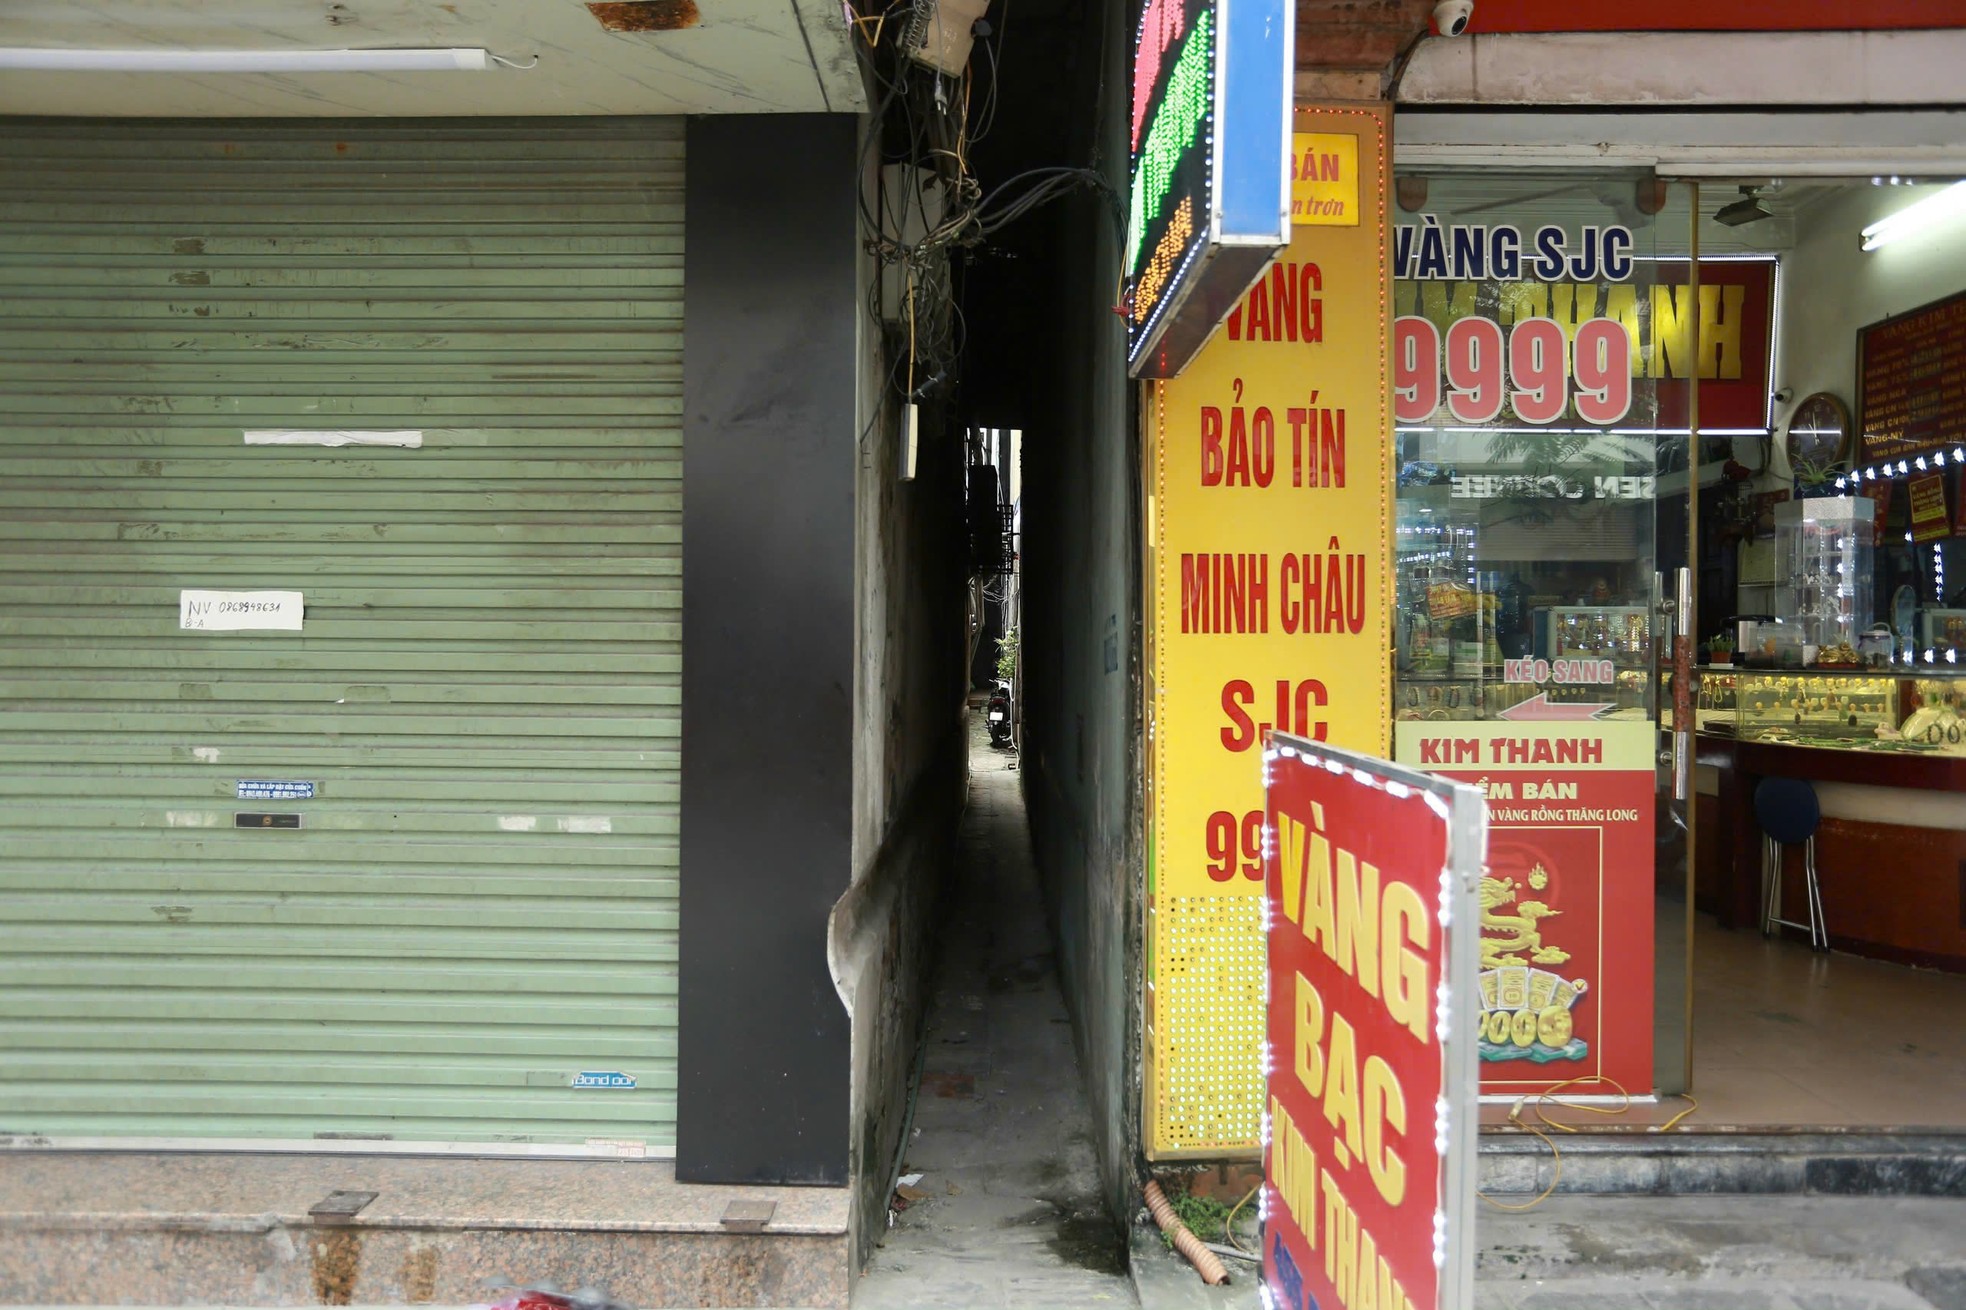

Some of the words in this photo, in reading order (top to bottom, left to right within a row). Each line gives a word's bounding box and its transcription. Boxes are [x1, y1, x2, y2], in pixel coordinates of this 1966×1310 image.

[1393, 213, 1522, 280] VÀNG
[1533, 224, 1634, 281] SJC
[1394, 315, 1631, 424] 9999
[1201, 378, 1275, 488] BẢO
[1286, 390, 1345, 488] TÍN
[1181, 553, 1268, 634] MINH
[1280, 536, 1366, 634] CHÂU
[1504, 655, 1549, 684] KÉO
[1552, 659, 1614, 684] SANG
[1220, 679, 1328, 752] SJC
[1419, 738, 1480, 764] KIM
[1489, 737, 1603, 764] THANH
[1497, 807, 1529, 821] VÀNG
[1566, 807, 1604, 821] THĂNG
[1606, 809, 1638, 821] LONG
[1522, 779, 1577, 800] BÁN
[1278, 800, 1429, 1044] VÀNG
[1294, 970, 1406, 1206] BẠC
[1271, 1094, 1315, 1250] KIM
[1321, 1168, 1415, 1310] THAN
